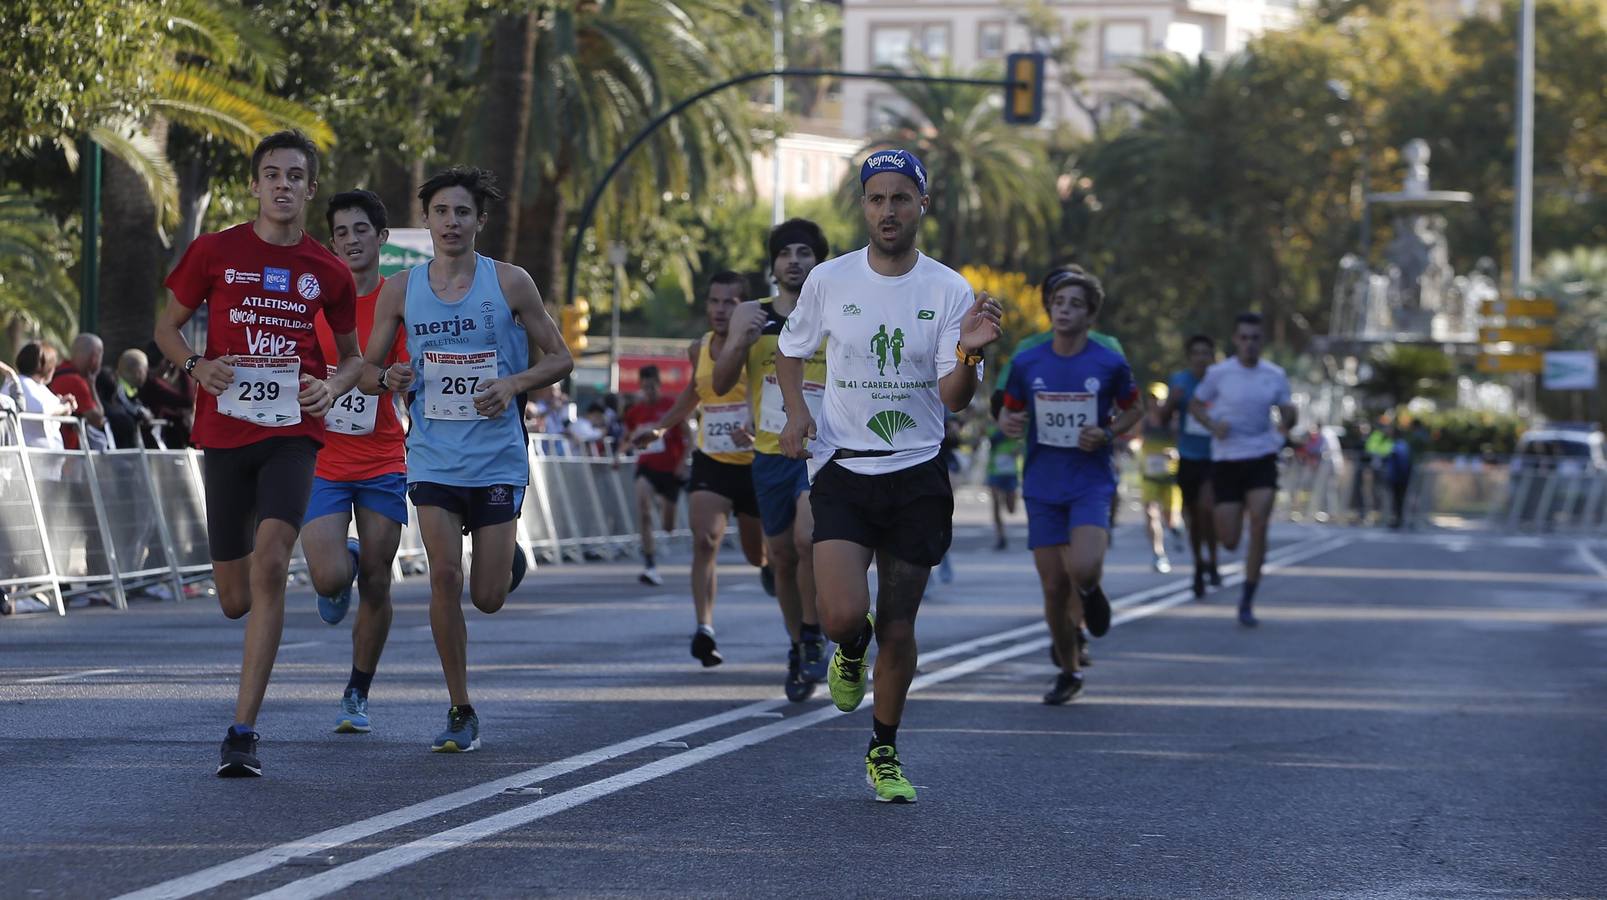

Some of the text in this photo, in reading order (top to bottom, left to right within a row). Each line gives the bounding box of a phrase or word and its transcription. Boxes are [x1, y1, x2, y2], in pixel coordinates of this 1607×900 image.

[867, 154, 906, 169] Reynolds
[242, 296, 307, 314] ATLETISMO
[259, 316, 313, 330] FERTILIDAD
[413, 315, 477, 337] nerja
[246, 326, 297, 357] Vélez
[424, 337, 470, 348] ATLETISMO
[468, 351, 496, 360] URBANA
[238, 381, 280, 401] 239
[441, 376, 480, 395] 267
[847, 381, 927, 389] 41 CARRERA URBANA
[1045, 412, 1088, 428] 3012
